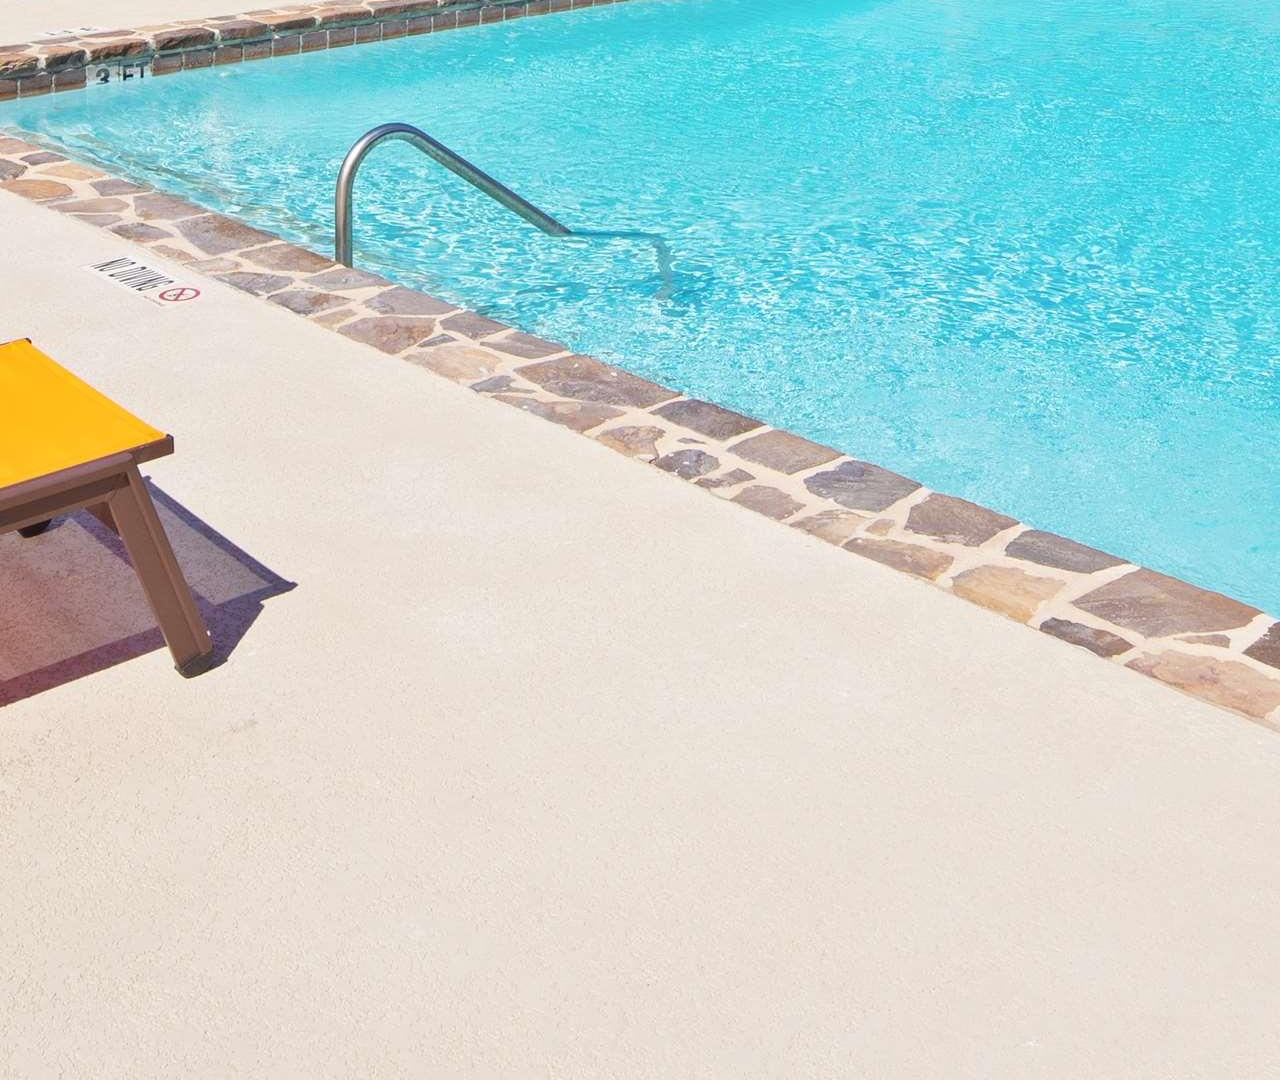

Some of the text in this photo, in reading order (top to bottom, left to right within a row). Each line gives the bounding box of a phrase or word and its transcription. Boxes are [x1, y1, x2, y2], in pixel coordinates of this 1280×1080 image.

[122, 62, 148, 81] FT
[90, 257, 175, 291] NO DIVING
